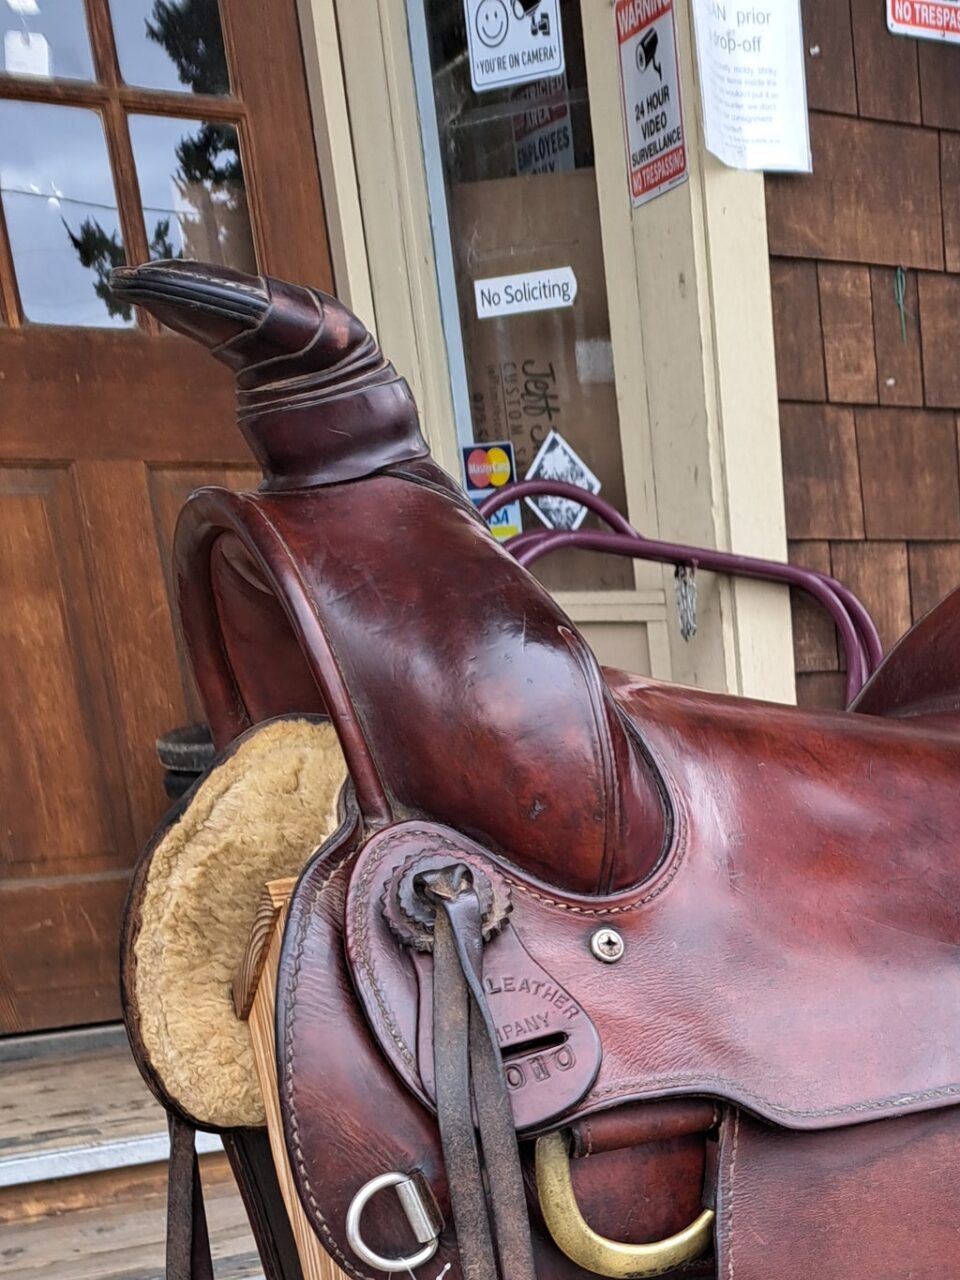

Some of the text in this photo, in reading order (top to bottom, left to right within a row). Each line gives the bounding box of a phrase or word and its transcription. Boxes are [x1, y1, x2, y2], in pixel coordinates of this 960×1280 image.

[617, 0, 670, 37] WARNI
[736, 7, 772, 28] prior
[895, 1, 912, 21] NO
[509, 53, 520, 69] ON
[635, 84, 671, 122] 24 HOUR
[641, 112, 668, 141] VIDEO
[518, 126, 570, 171] EMPLOYEES
[632, 126, 682, 168] SURVEILLANCE
[633, 147, 685, 192] NO TRESPASSING
[480, 278, 571, 309] No Soliciting
[503, 361, 524, 435] CUSTOM
[520, 359, 561, 422] Jeff
[484, 976, 580, 1020] LEATHER
